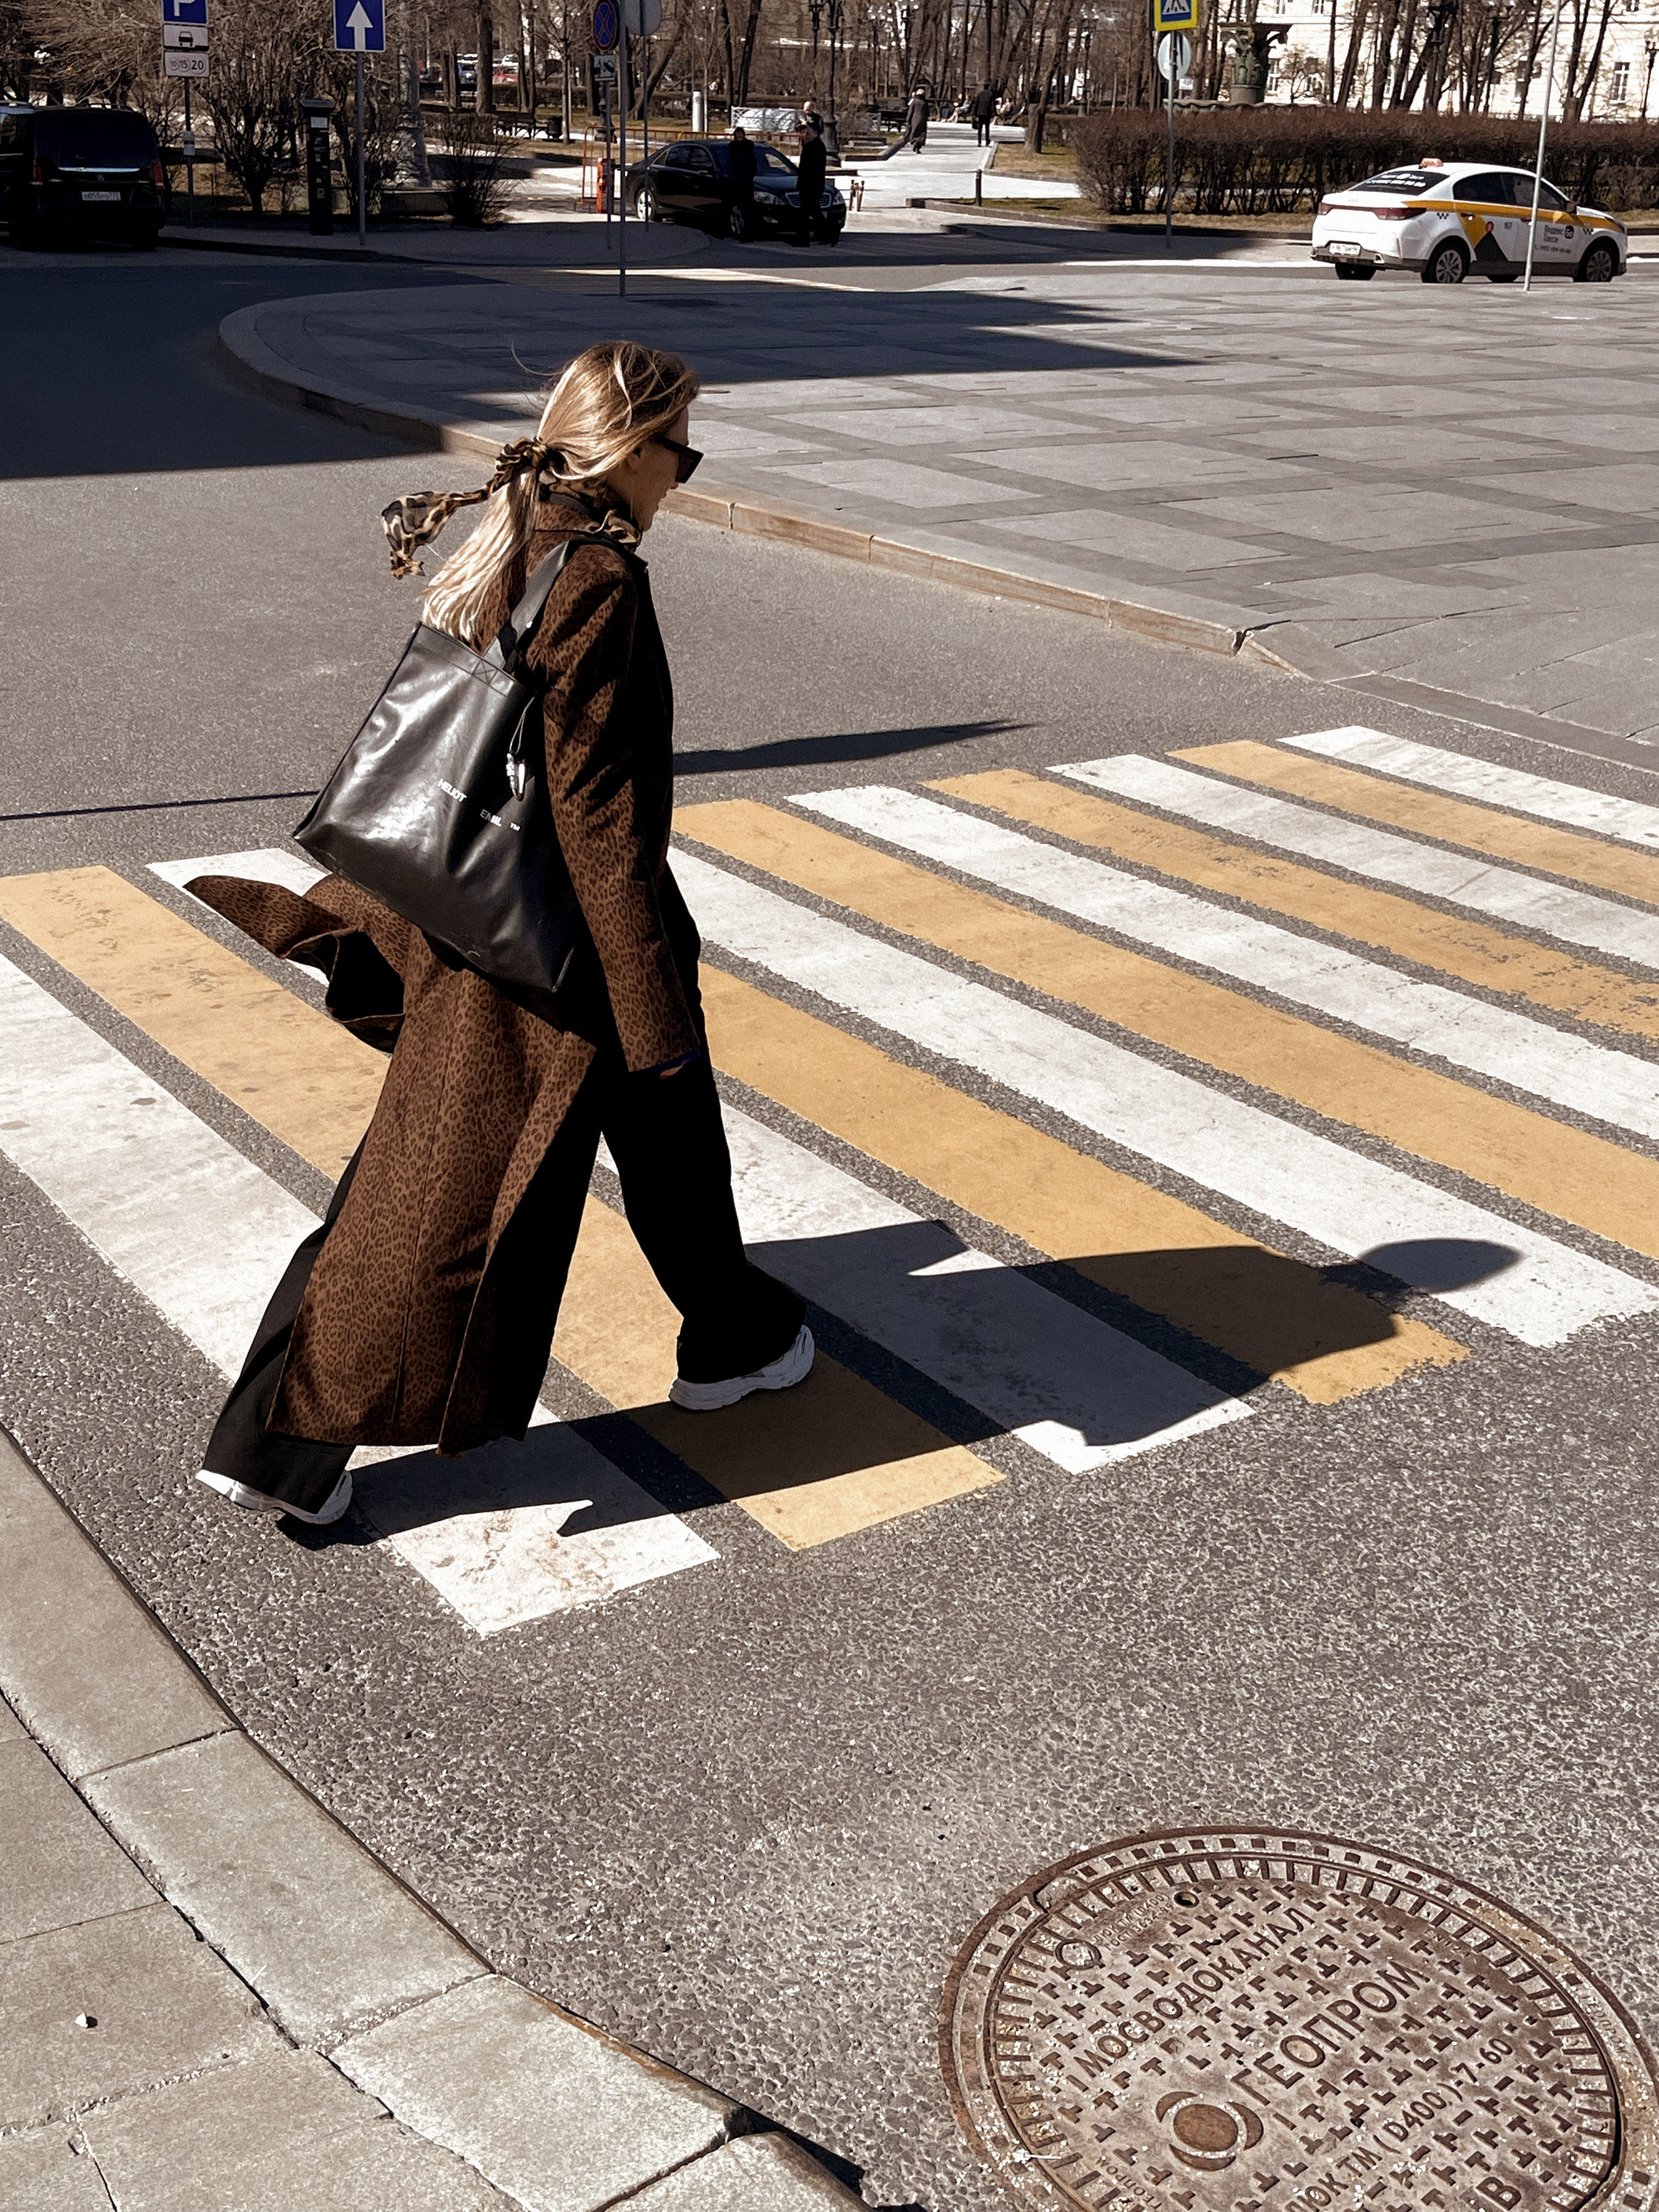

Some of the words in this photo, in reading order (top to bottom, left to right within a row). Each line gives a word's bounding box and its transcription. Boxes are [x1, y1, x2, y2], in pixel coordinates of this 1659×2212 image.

[191, 60, 204, 70] 20
[437, 778, 467, 802] HELIOT
[1104, 1931, 1132, 1952] ГОСТ
[1073, 1907, 1316, 2078] МОСВОДОКАНАЛ
[1230, 1961, 1432, 2106] ГЕОПРОМ
[1335, 2146, 1382, 2178] ТМ
